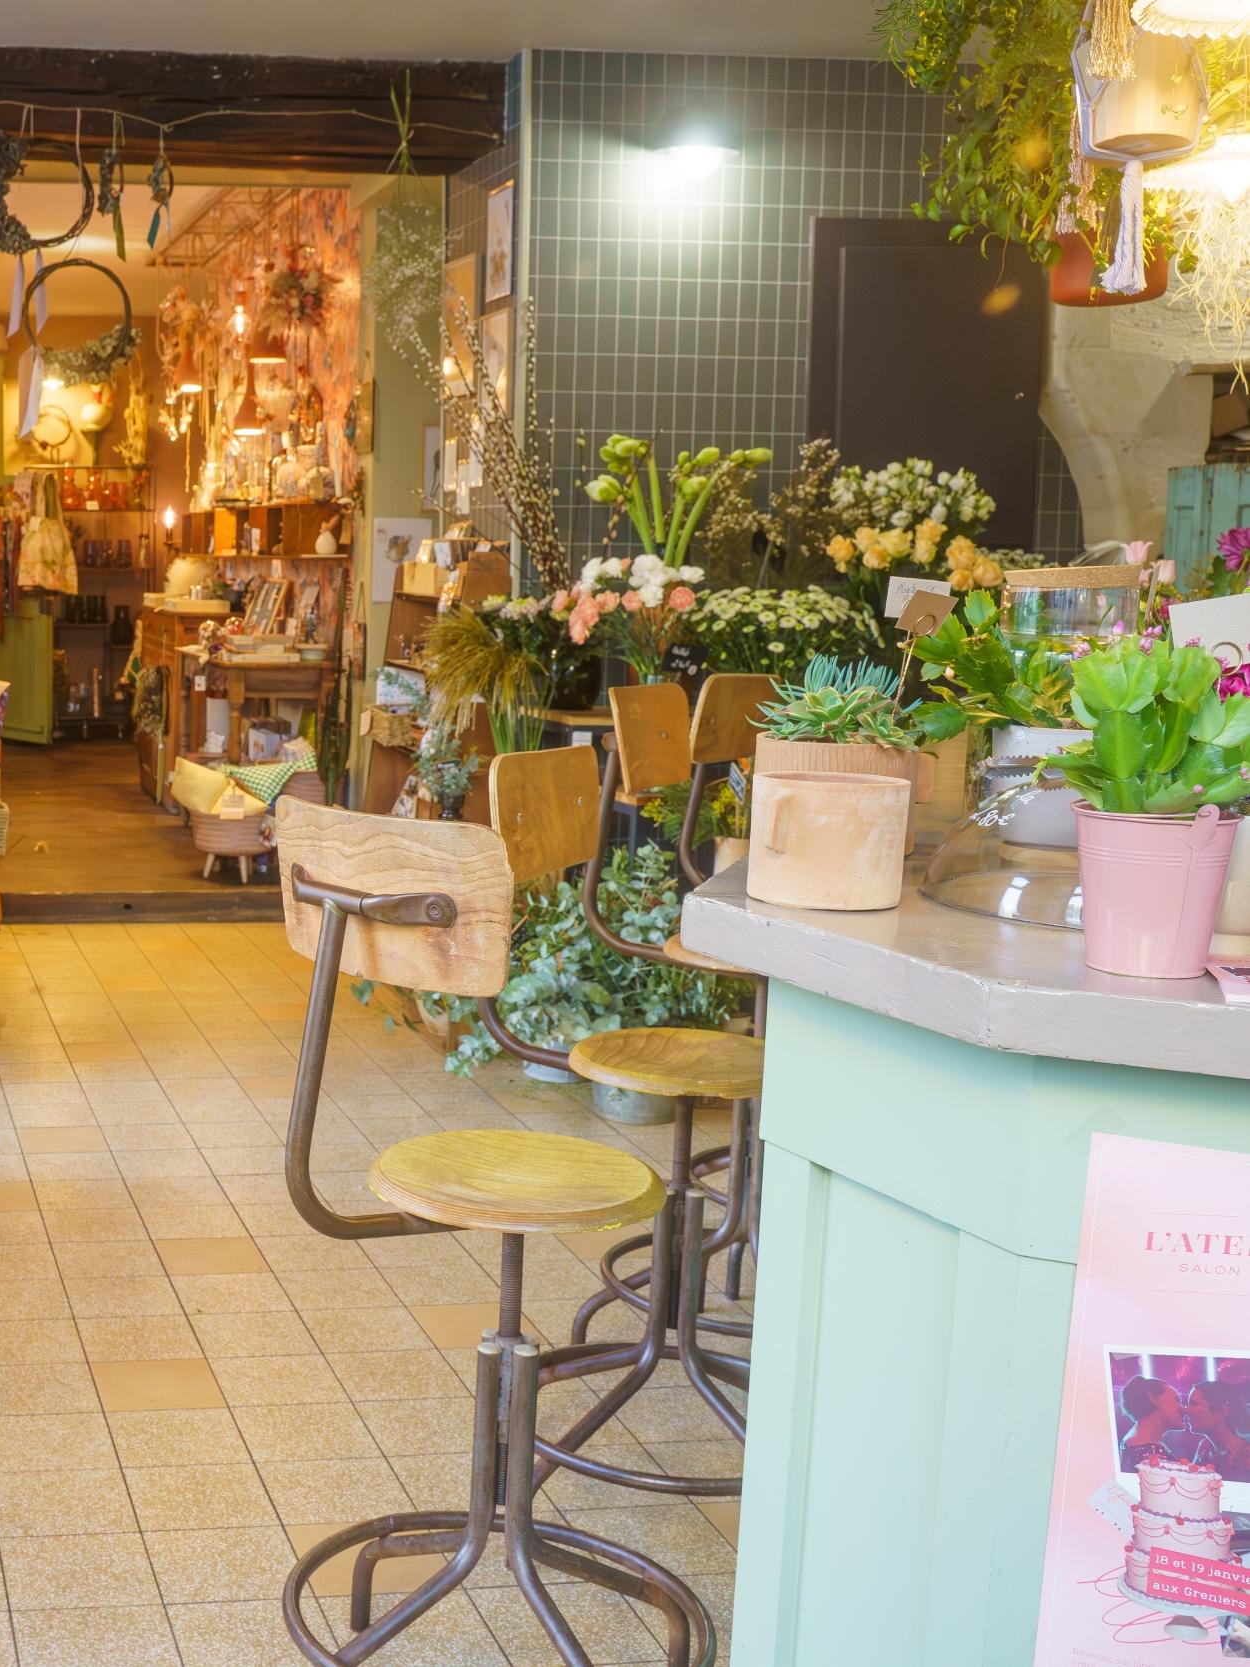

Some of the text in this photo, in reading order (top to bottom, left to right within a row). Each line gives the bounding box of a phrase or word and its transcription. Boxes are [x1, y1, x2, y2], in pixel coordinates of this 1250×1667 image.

[1145, 1231, 1250, 1257] L'ATE
[1179, 1263, 1240, 1276] SALON
[1155, 1554, 1169, 1565] 18
[1173, 1560, 1187, 1569] et
[1191, 1562, 1205, 1573] 19
[1152, 1582, 1247, 1609] aux Greniers
